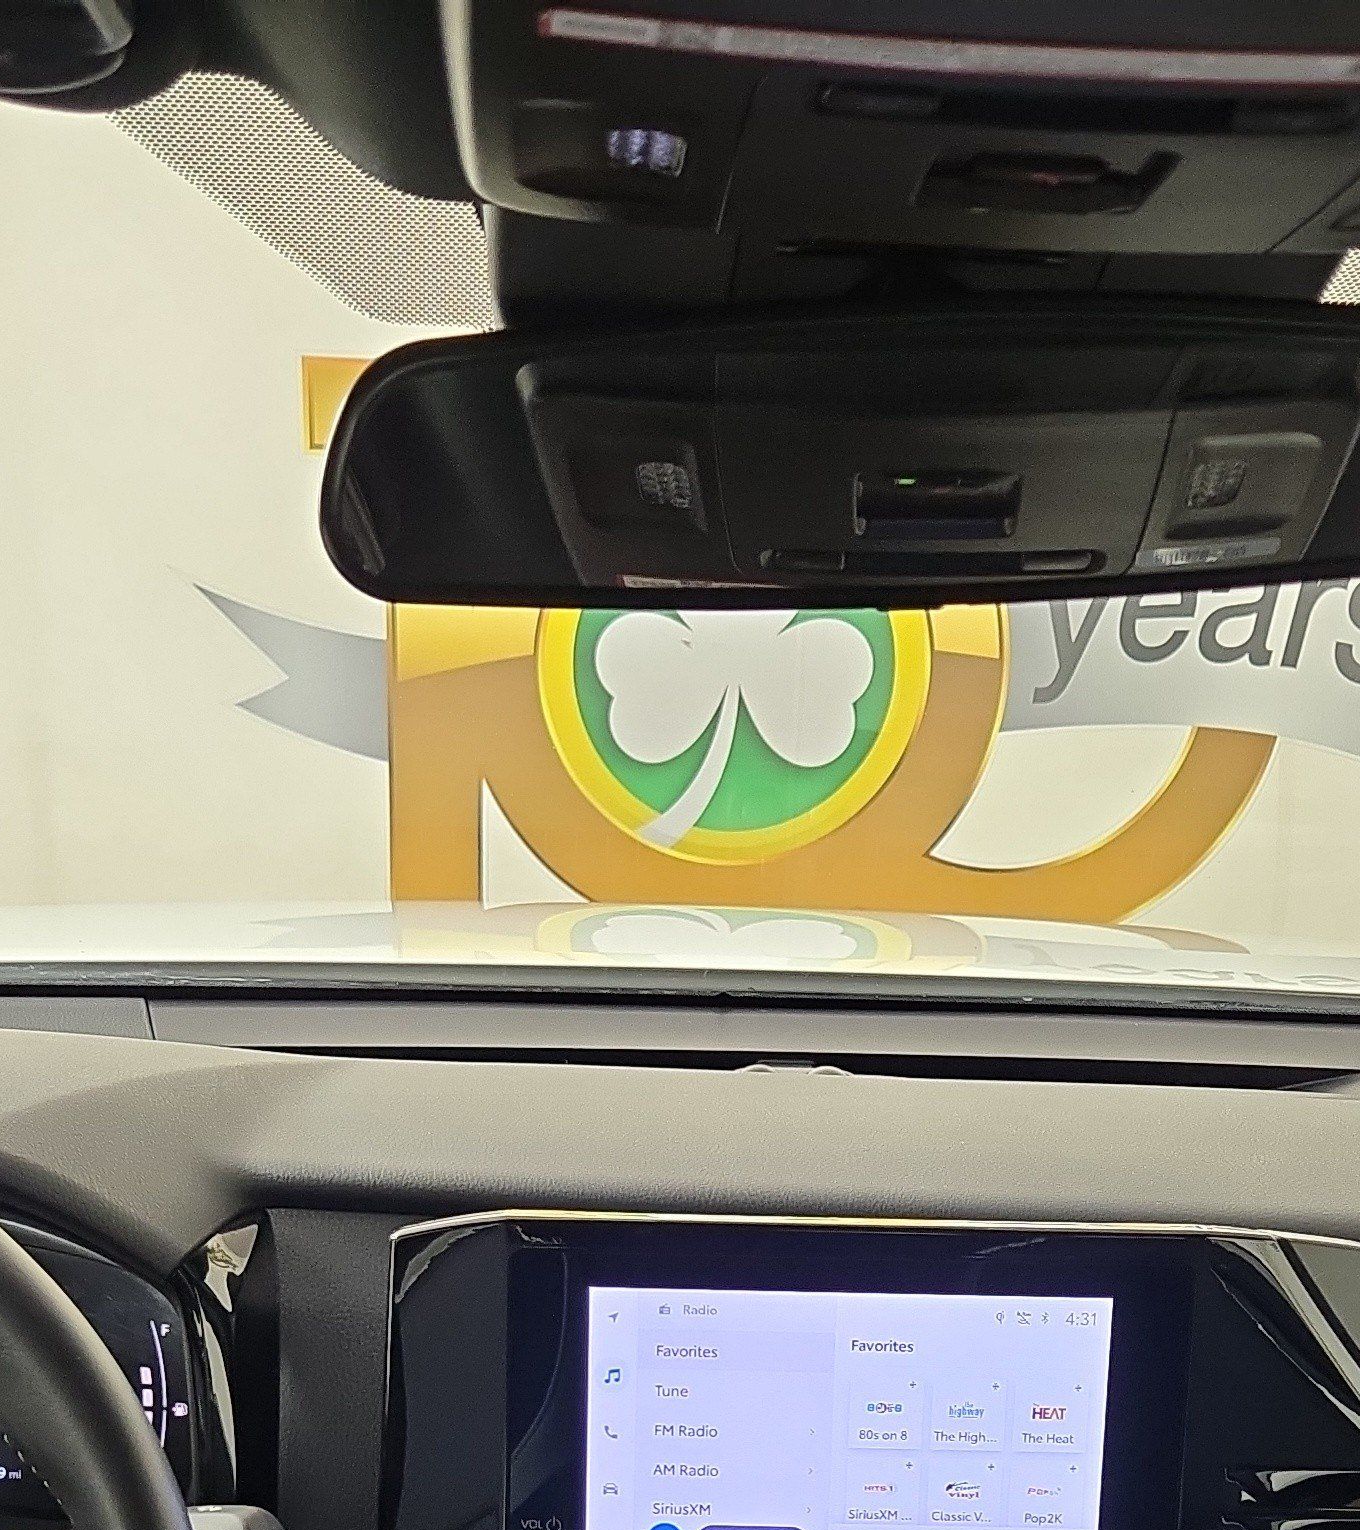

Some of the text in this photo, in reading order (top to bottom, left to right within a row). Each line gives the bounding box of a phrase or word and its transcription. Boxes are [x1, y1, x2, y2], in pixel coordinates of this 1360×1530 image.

[683, 1304, 718, 1316] Radio
[1065, 1312, 1098, 1326] 4:31
[160, 1323, 171, 1337] F
[656, 1344, 718, 1358] Favorites
[851, 1339, 914, 1353] Favorites
[655, 1384, 689, 1398] Tune
[1032, 1407, 1067, 1420] HEAT
[654, 1424, 718, 1438] FM Radio
[858, 1430, 908, 1441] 80s on 8
[934, 1431, 956, 1442] The
[1022, 1432, 1074, 1444] The Heat
[8, 1468, 22, 1480] mi
[653, 1464, 719, 1477] AM Radio
[652, 1502, 711, 1515] SiriusXM
[848, 1509, 898, 1521] SiriusXM
[931, 1511, 972, 1522] Classic
[1024, 1513, 1063, 1526] Pop2K
[520, 1518, 543, 1530] VOL
